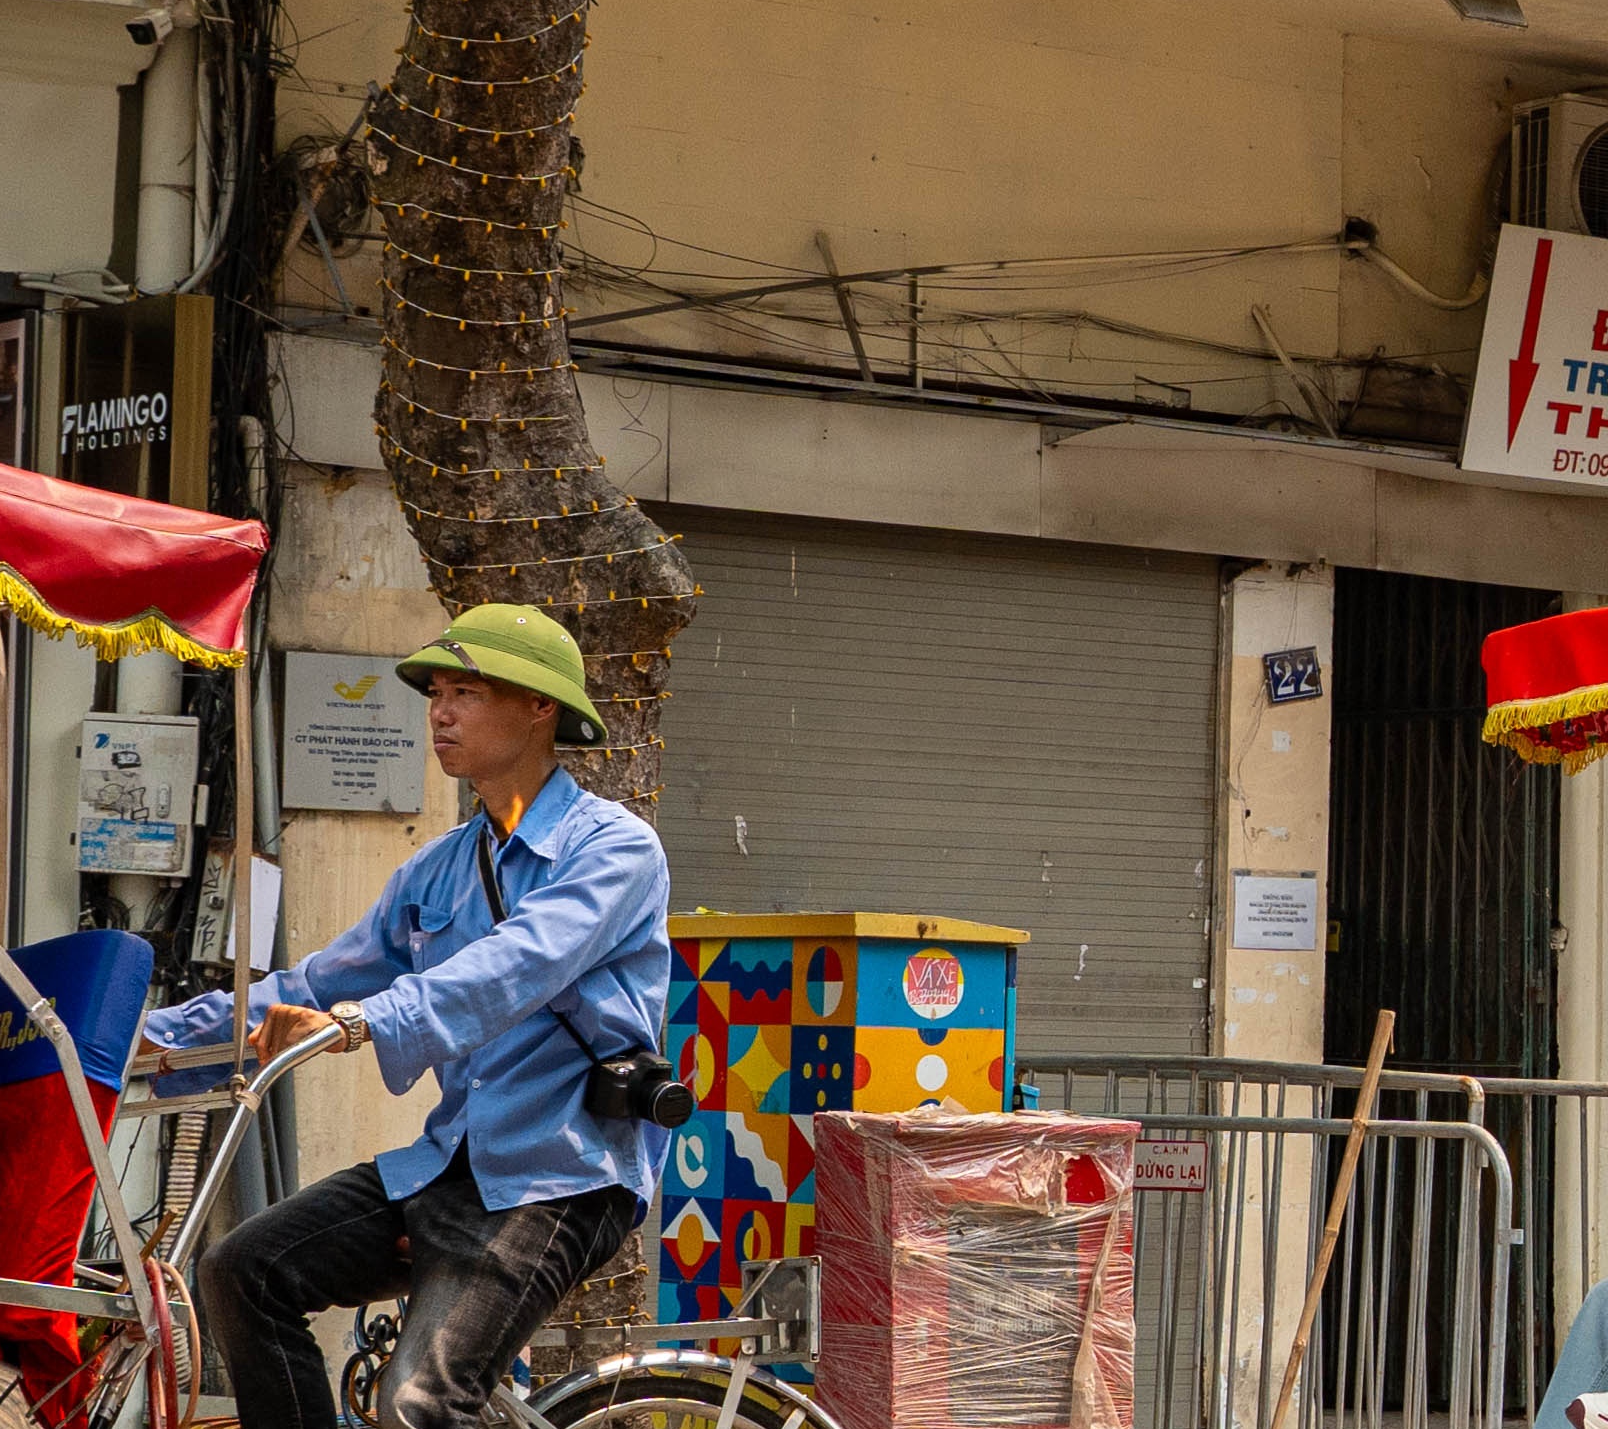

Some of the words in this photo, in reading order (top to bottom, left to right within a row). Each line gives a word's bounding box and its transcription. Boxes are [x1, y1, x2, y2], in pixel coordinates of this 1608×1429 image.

[61, 392, 168, 455] FLAMINGO
[76, 425, 168, 452] HOLDINGS
[1274, 657, 1316, 696] 22
[326, 701, 361, 709] VIETNAM
[295, 735, 307, 744] CT
[1136, 1158, 1174, 1179] DỪNG
[1180, 1165, 1202, 1184] LẠI
